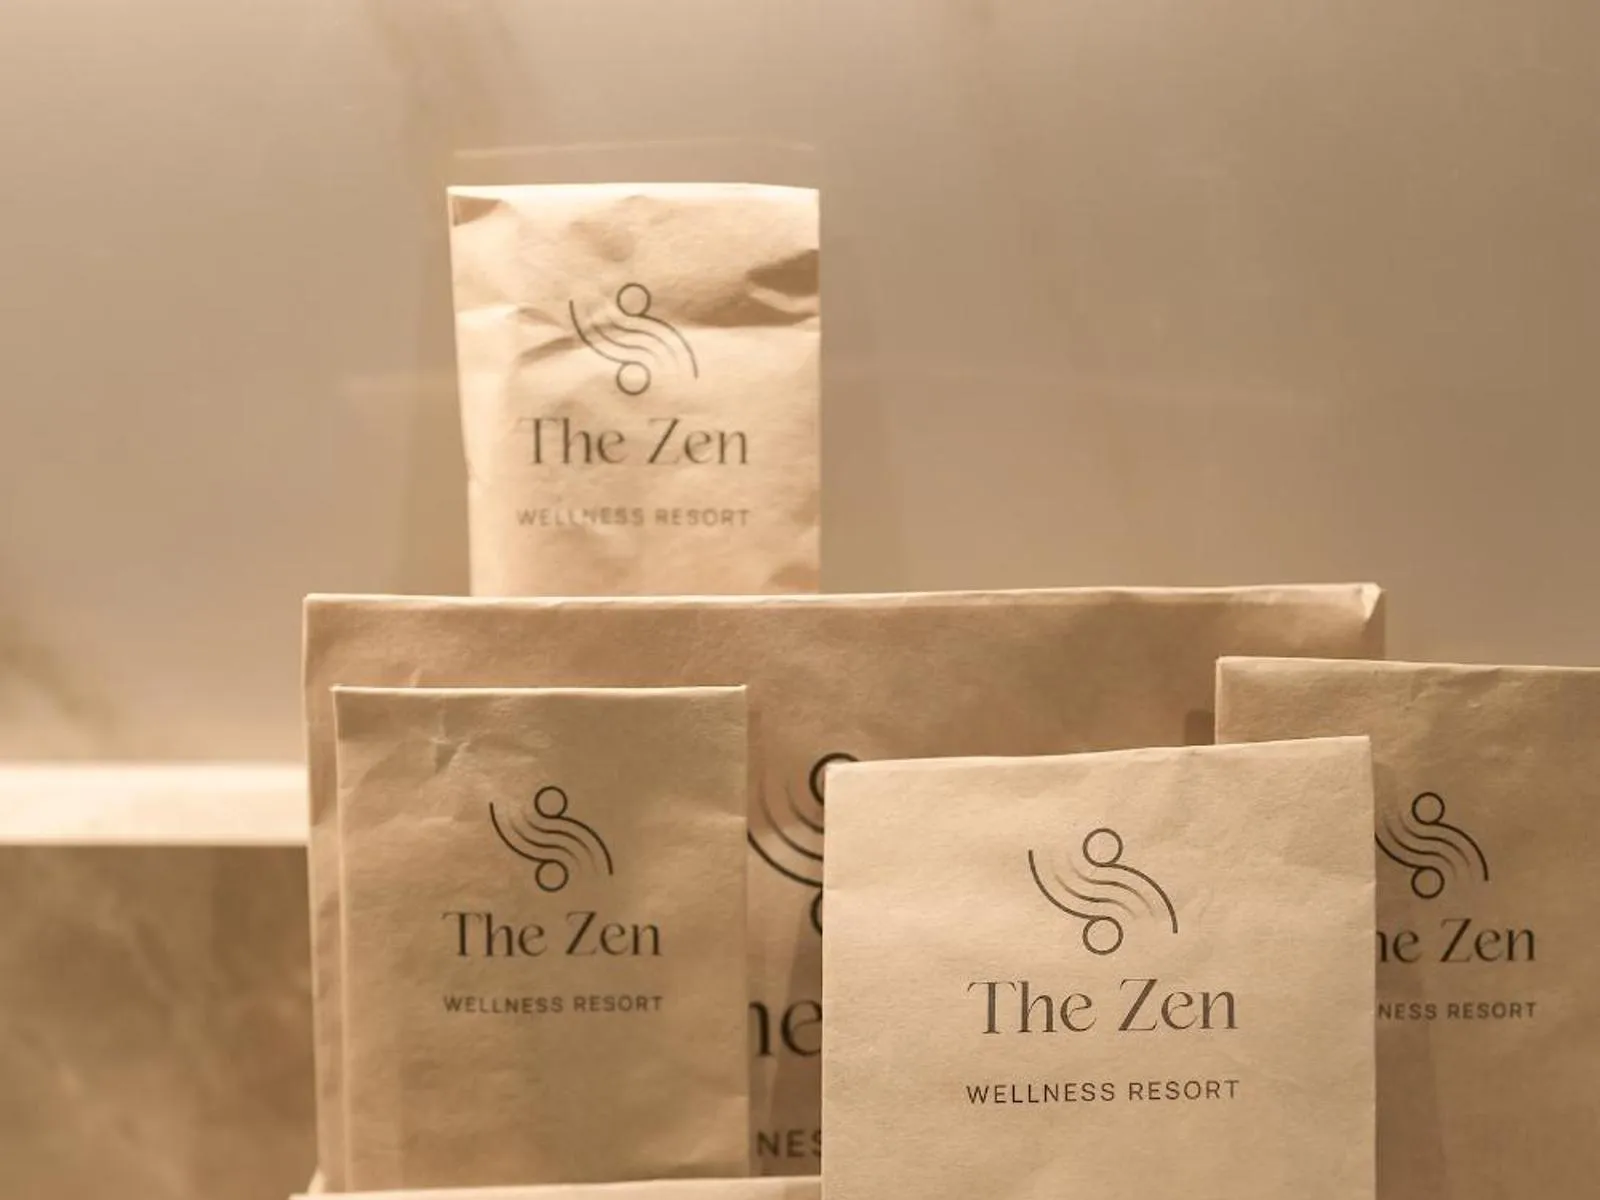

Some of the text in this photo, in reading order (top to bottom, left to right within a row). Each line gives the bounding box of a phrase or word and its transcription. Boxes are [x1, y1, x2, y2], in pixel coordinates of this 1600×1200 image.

[516, 416, 749, 465] The Zen
[516, 508, 750, 527] WELLNESS RESORT
[442, 911, 663, 957] The Zen
[1440, 918, 1536, 963] Zen
[443, 996, 663, 1014] WELLNESS RESORT
[967, 978, 1239, 1034] The Zen
[1378, 1002, 1537, 1020] NESS RESORT
[966, 1080, 1240, 1104] WELLNESS RESORT
